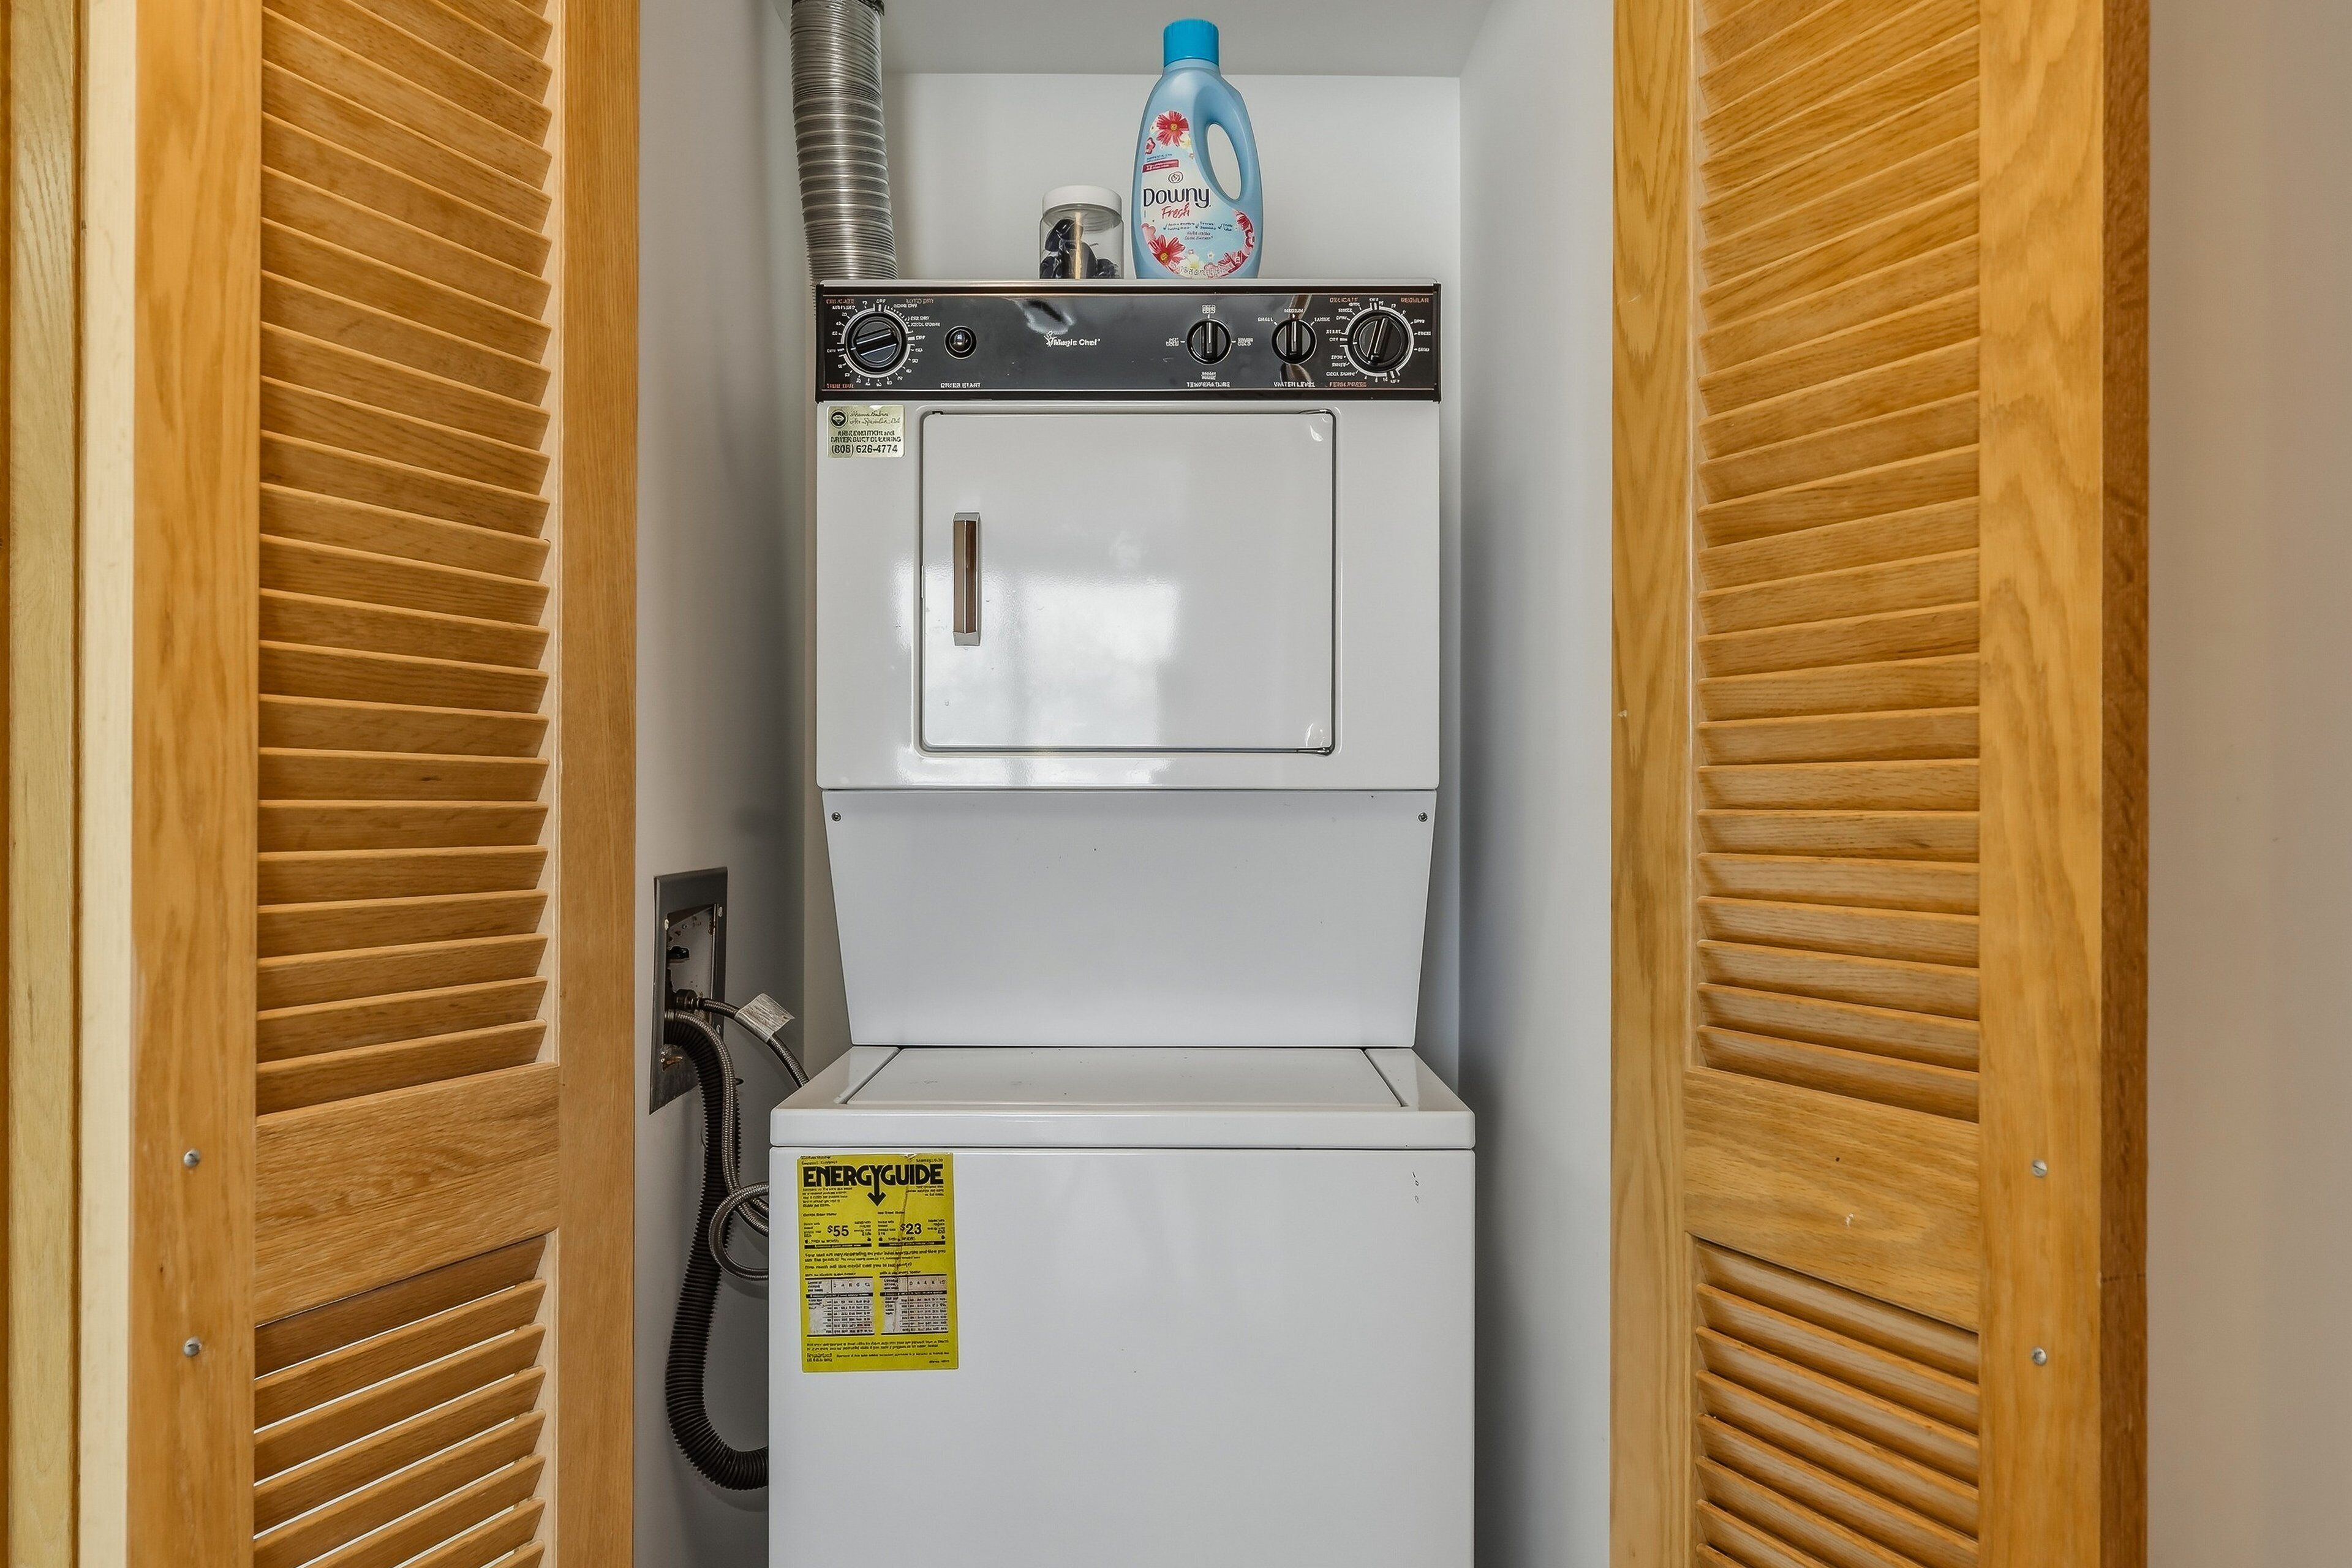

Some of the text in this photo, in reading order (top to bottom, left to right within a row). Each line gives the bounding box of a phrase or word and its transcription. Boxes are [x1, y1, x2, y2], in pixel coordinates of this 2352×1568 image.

[1143, 187, 1210, 209] Downy
[1161, 202, 1189, 219] Fresh
[827, 1224, 850, 1237] $55
[900, 1223, 922, 1235] $23
